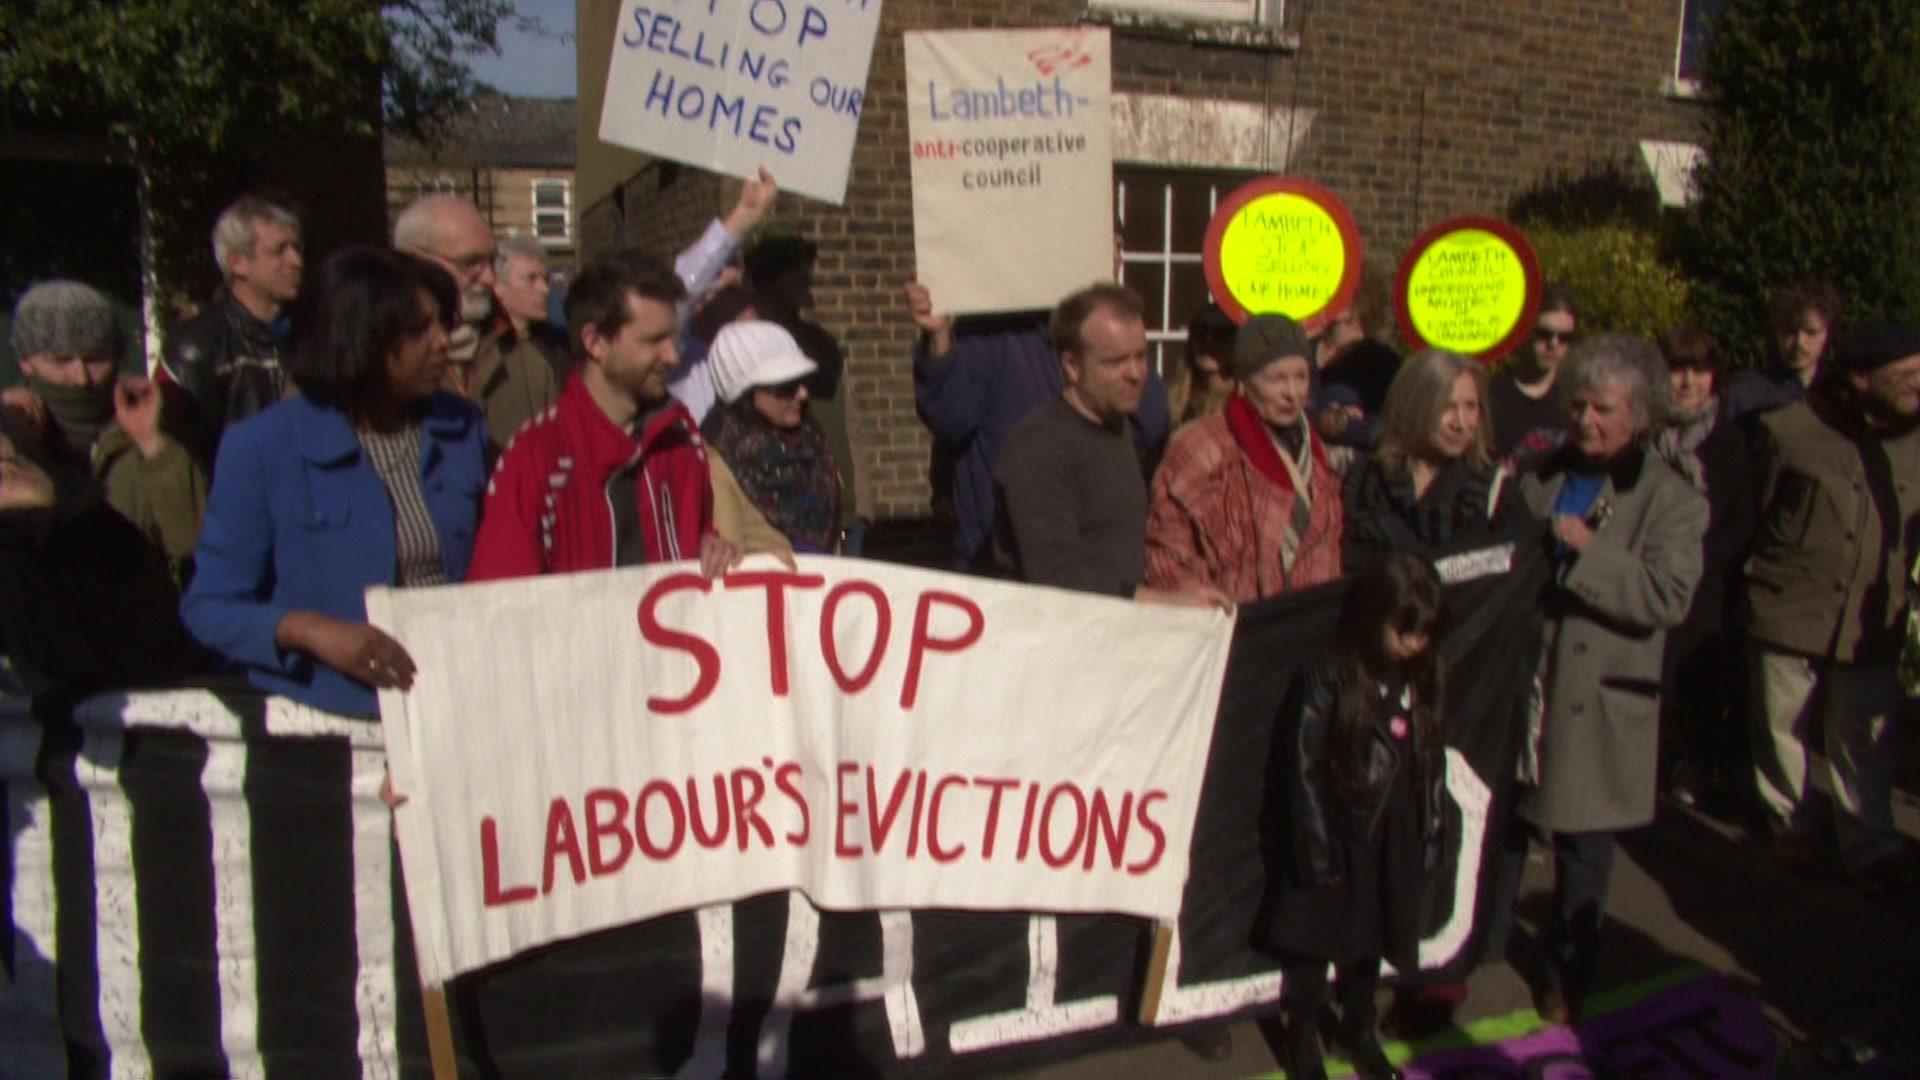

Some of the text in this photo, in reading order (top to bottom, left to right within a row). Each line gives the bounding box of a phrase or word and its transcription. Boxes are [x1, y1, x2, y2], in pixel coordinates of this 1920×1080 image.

[623, 7, 865, 117] SELLING OUR
[645, 70, 802, 153] HOMES
[962, 163, 1041, 189] council
[1243, 208, 1332, 235] LAMBETH
[1426, 248, 1506, 265] LAMBETH
[637, 570, 985, 716] STOP
[480, 757, 1168, 908] LABOUR'S EVICTIONS
